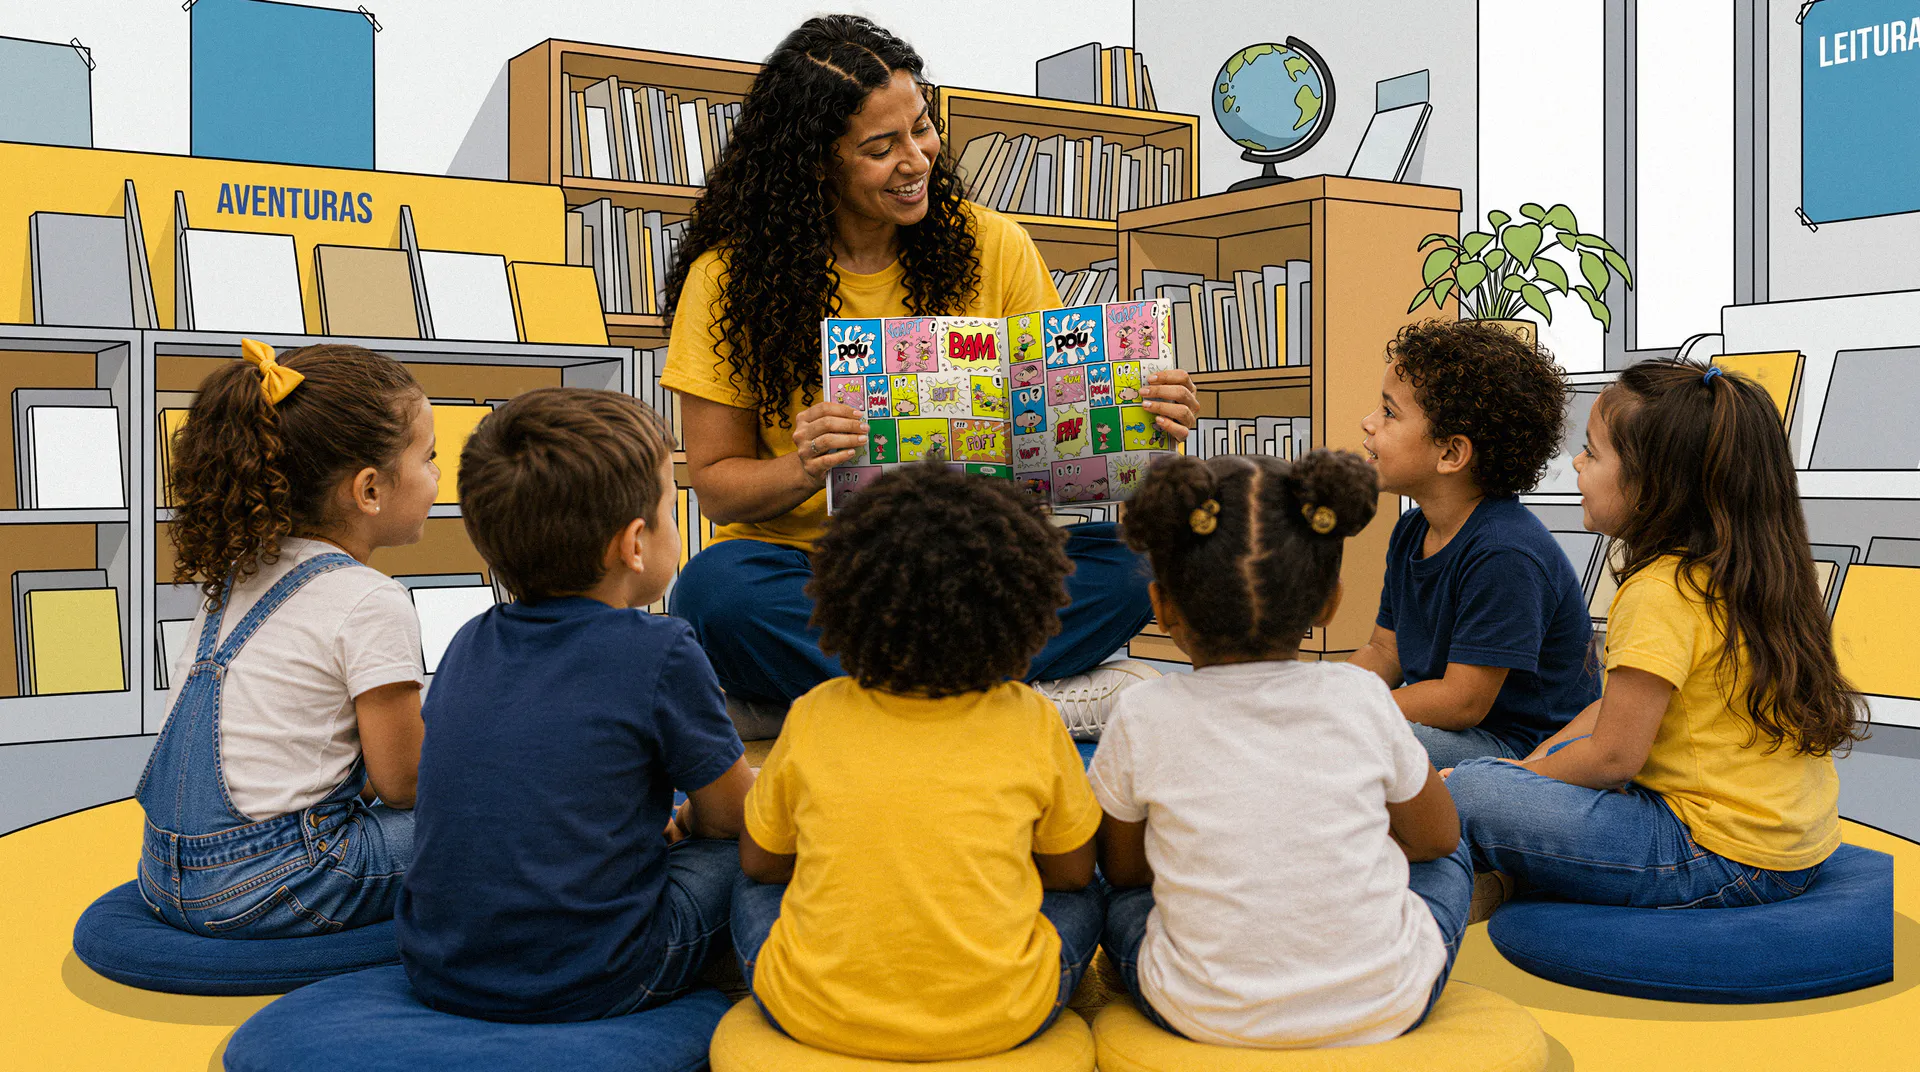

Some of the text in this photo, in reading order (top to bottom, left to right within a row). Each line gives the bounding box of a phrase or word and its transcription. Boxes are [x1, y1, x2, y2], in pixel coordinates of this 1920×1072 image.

[217, 183, 373, 224] AVENTURAS
[949, 331, 996, 362] BAM
[843, 383, 861, 393] TUM
[1063, 374, 1081, 384] TUM
[966, 434, 997, 450] POFT
[1055, 417, 1083, 445] PAF
